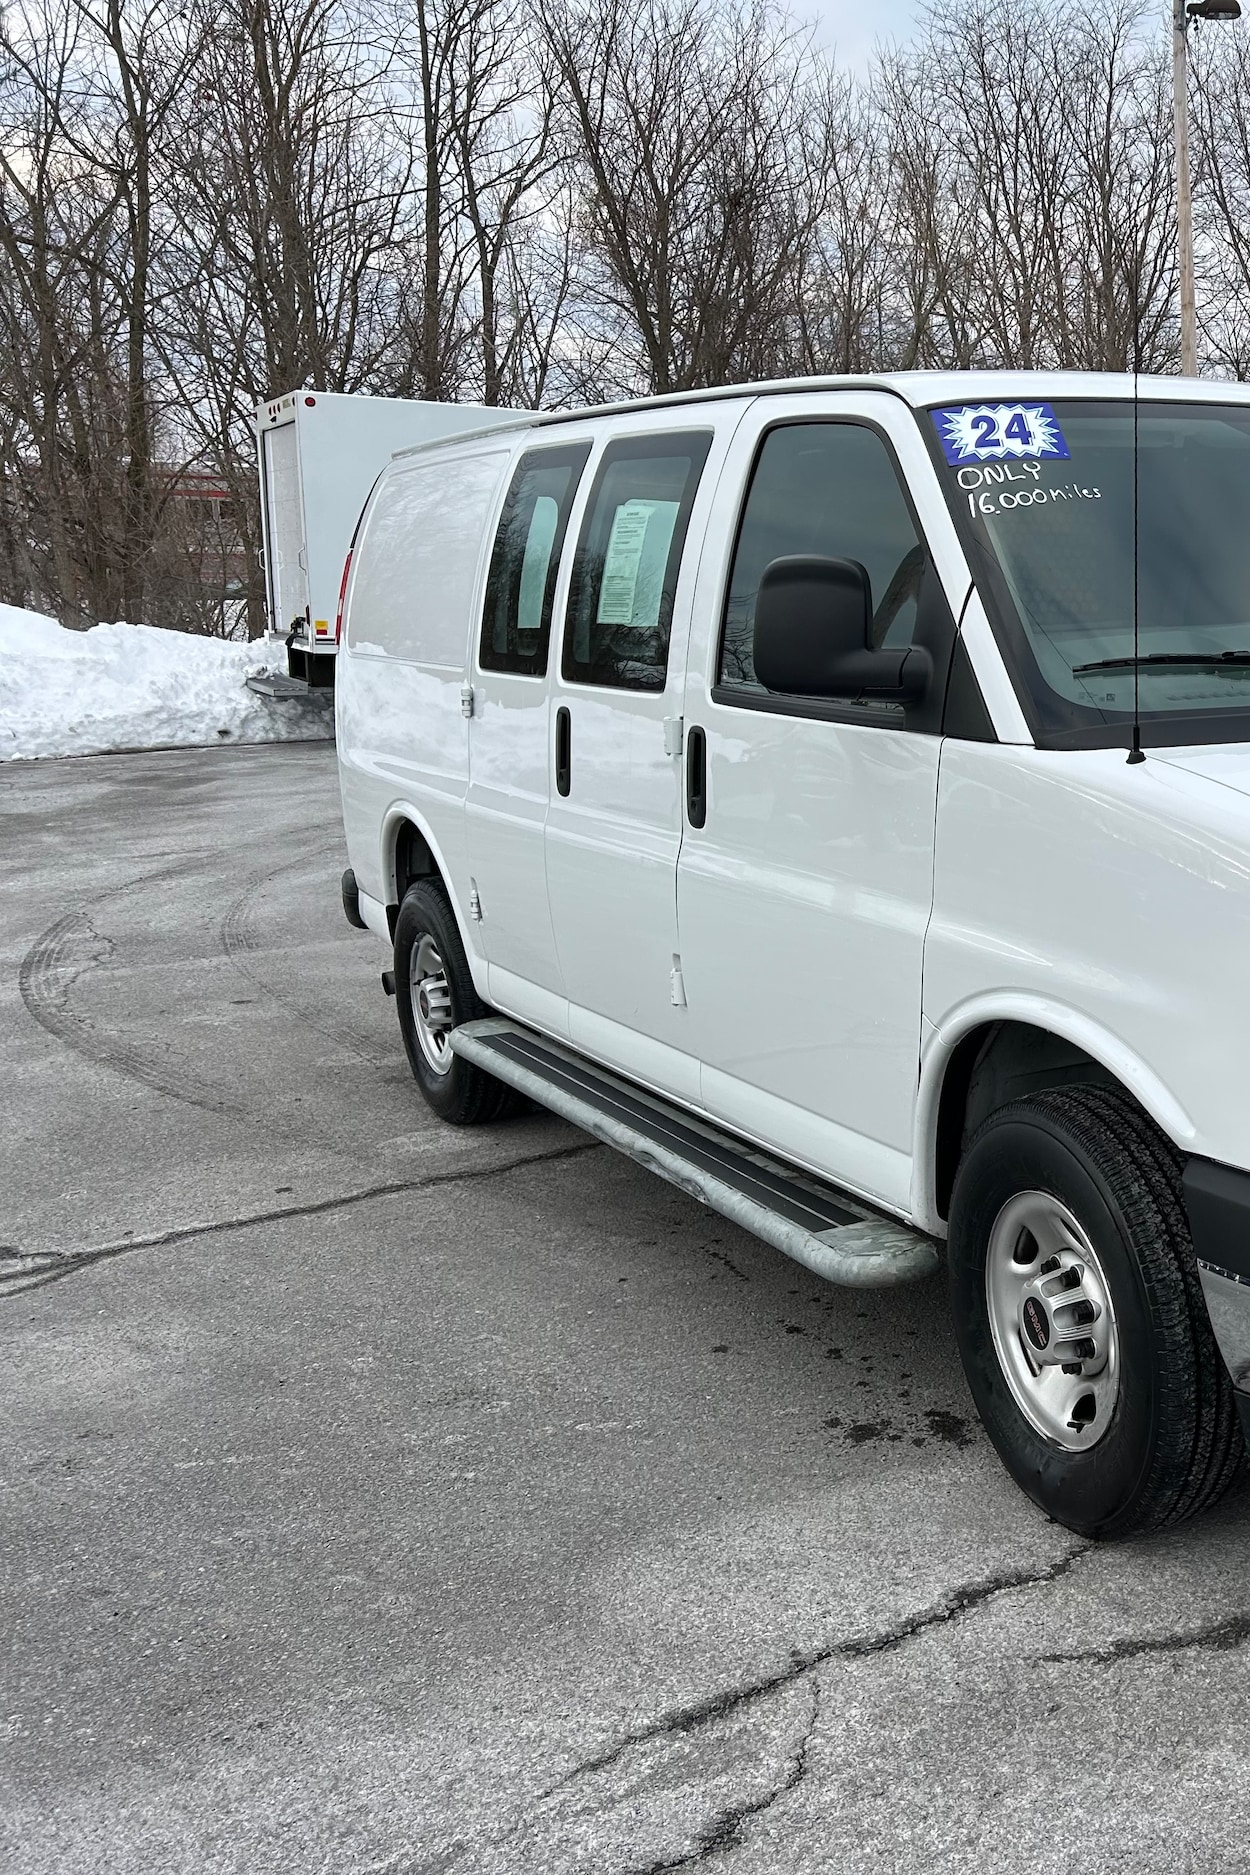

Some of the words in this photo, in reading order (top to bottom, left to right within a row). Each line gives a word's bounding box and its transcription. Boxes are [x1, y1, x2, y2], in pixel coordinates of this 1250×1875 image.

[970, 413, 1034, 449] 24
[957, 461, 1041, 490] ONLY
[1026, 1300, 1047, 1347] GMC
